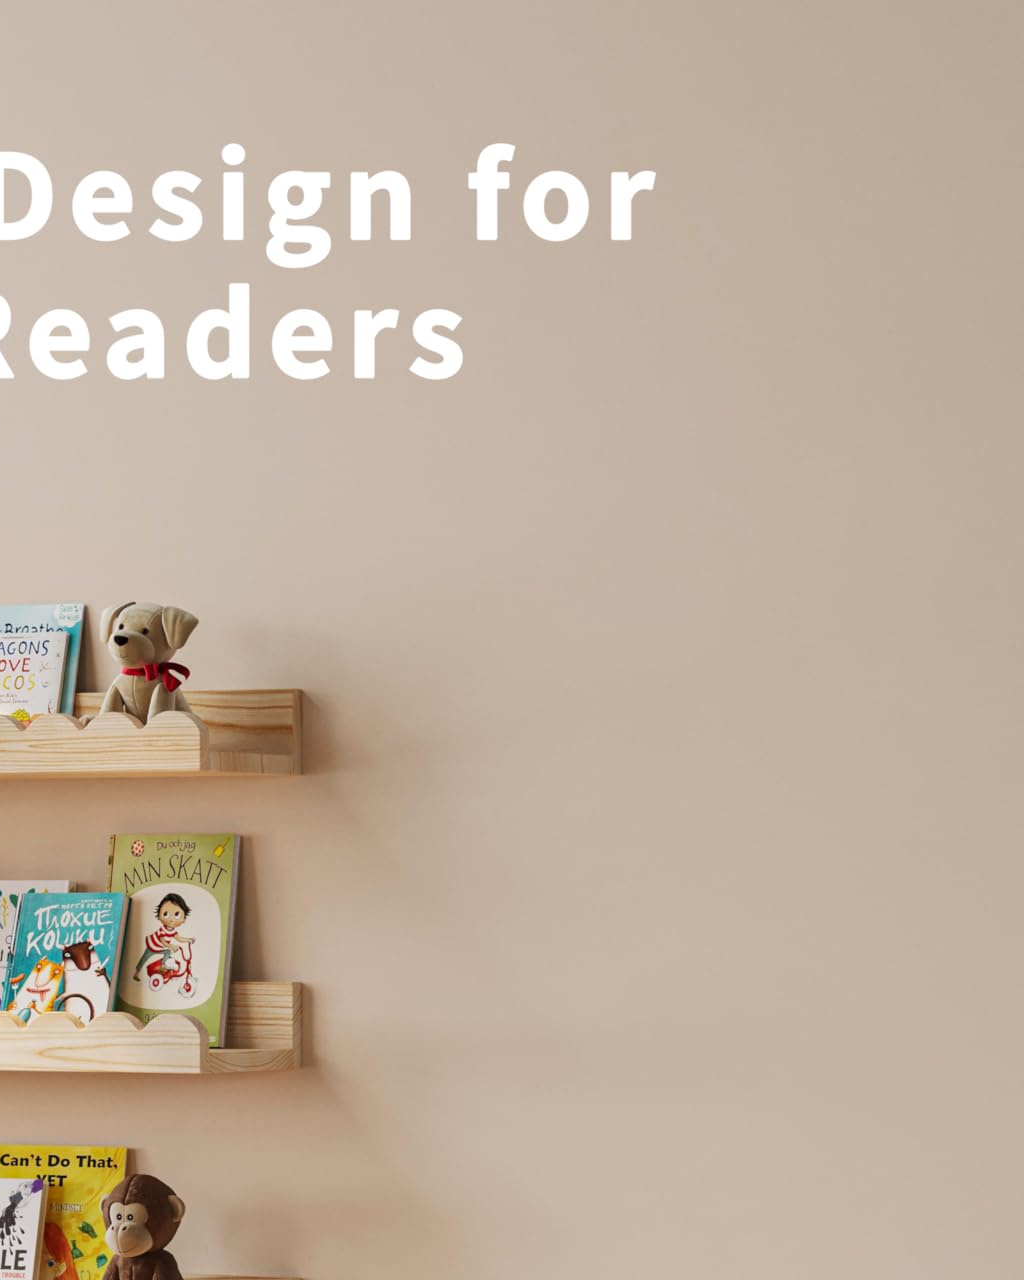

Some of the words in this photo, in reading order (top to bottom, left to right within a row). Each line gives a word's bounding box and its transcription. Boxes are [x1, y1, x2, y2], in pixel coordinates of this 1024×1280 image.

[156, 841, 167, 851] Du
[123, 857, 162, 893] MIN
[166, 854, 228, 889] SKATT
[0, 1154, 42, 1167] Can't
[47, 1155, 71, 1167] Do
[76, 1155, 118, 1169] That,
